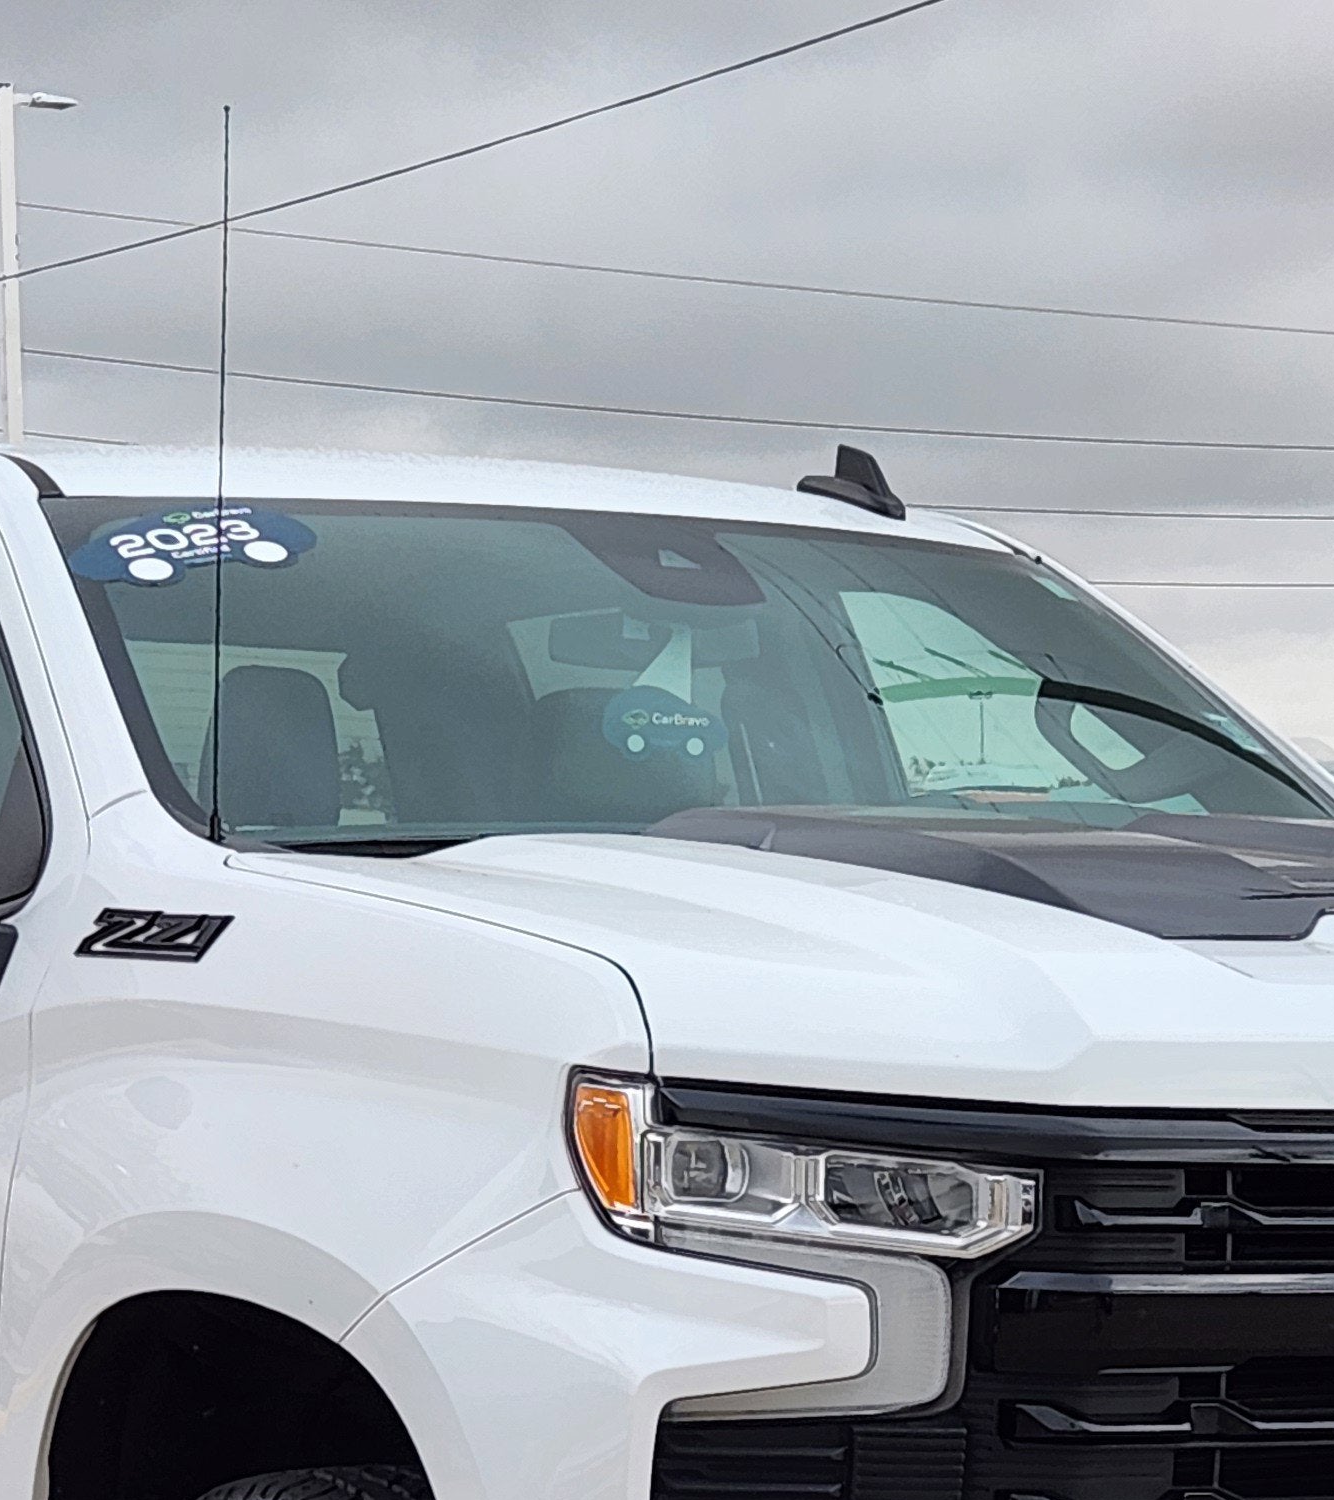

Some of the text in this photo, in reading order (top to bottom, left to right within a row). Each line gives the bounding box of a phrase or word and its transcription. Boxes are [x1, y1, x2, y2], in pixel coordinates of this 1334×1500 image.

[110, 519, 260, 558] 2023
[652, 712, 710, 727] CarBravo
[73, 907, 235, 963] Z71
